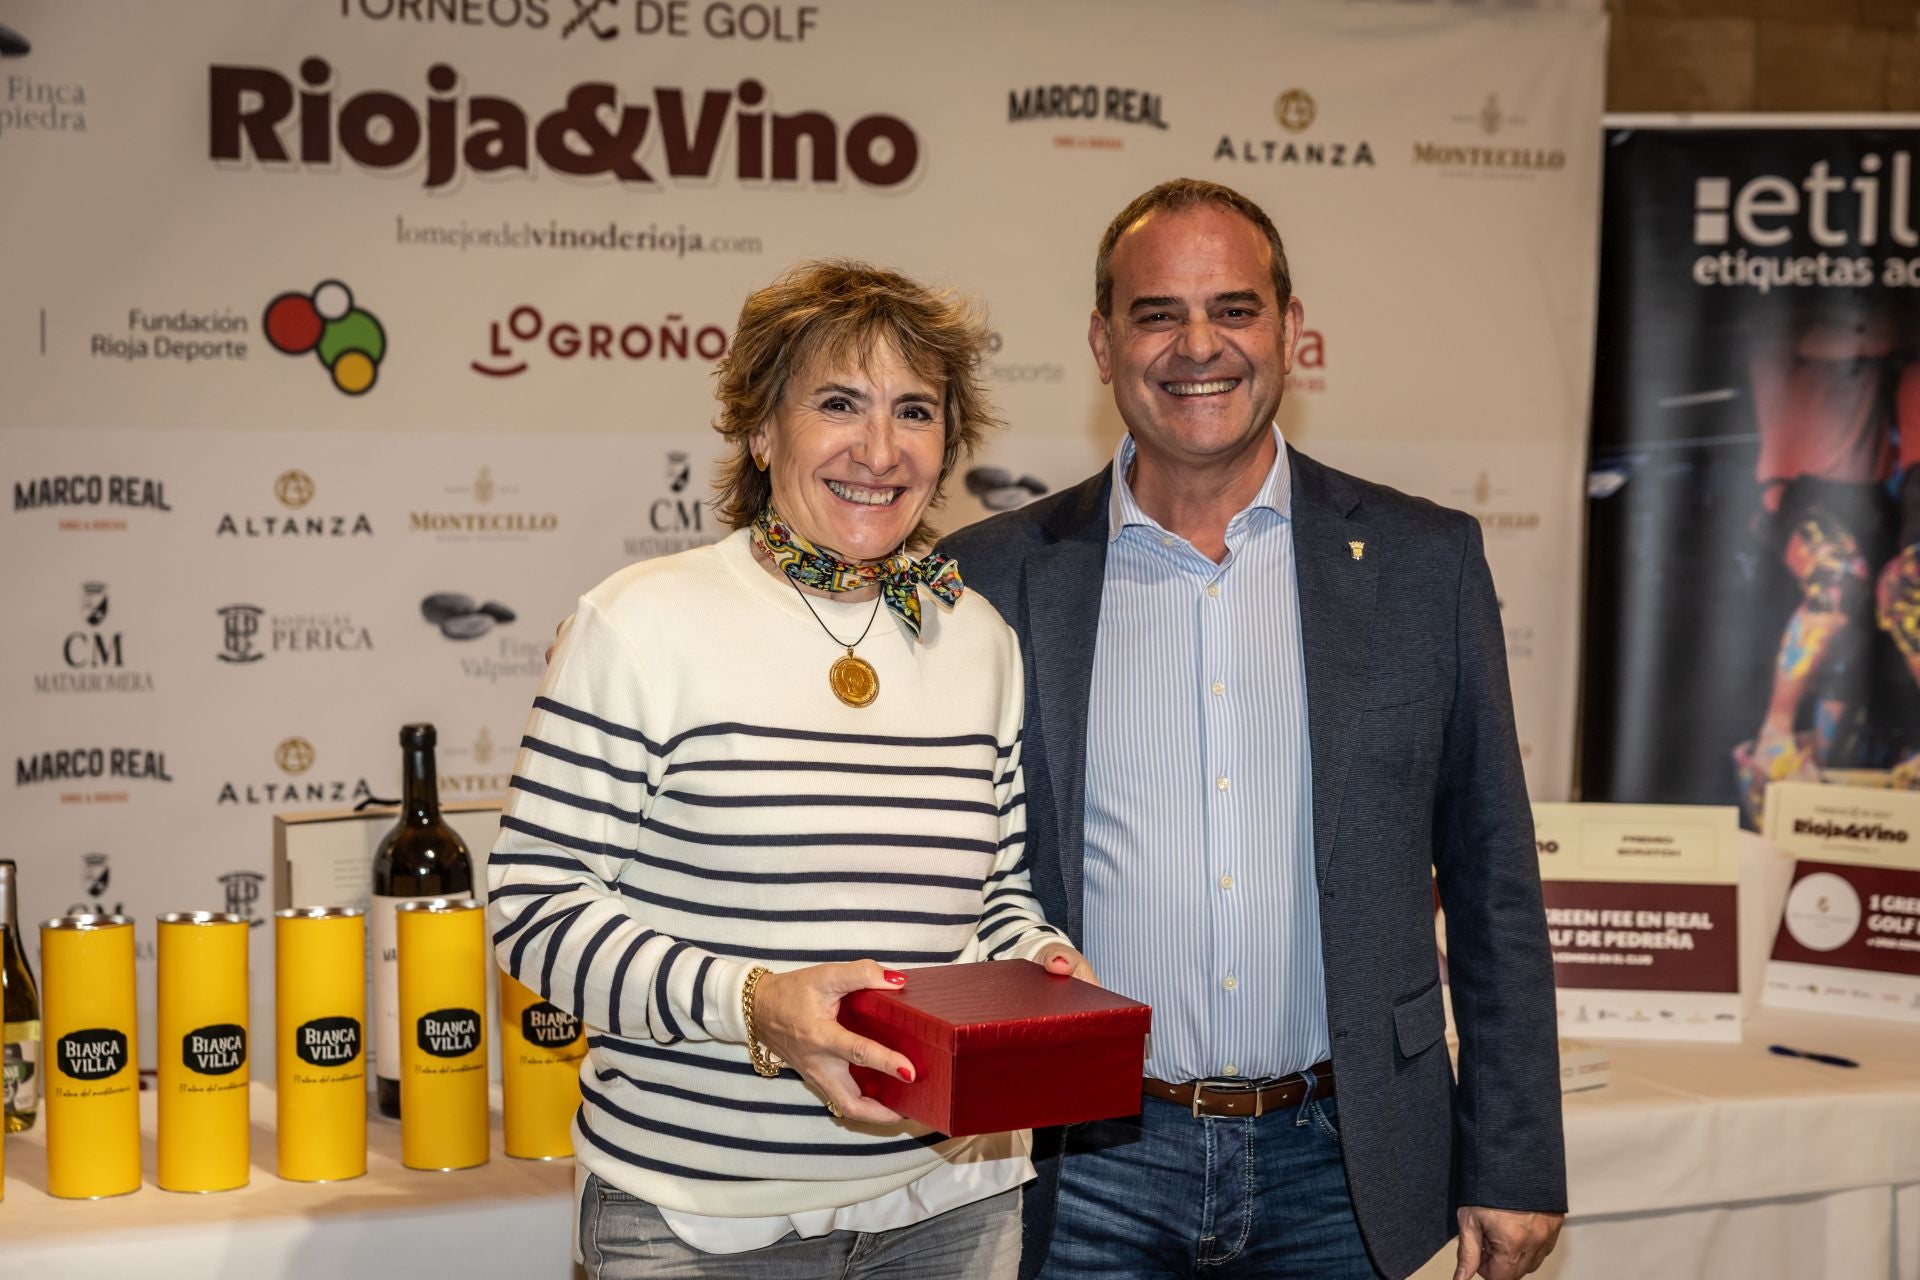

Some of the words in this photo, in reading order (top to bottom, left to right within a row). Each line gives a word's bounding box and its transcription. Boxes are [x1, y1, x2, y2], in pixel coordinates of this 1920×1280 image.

[635, 0, 690, 37] DE
[703, 2, 819, 43] GOLF
[8, 76, 87, 106] Finca
[1008, 83, 1099, 123] MARCO
[1104, 87, 1170, 131] REAL
[208, 56, 921, 190] Rioja&Vino
[1214, 135, 1376, 168] ALTANZA
[1411, 140, 1567, 173] MONTECILLO
[396, 215, 763, 259] lomejordelvinoderioja.com
[1692, 249, 1875, 294] etiquetas
[129, 307, 248, 334] Fundación
[490, 304, 727, 360] LOGROÑO
[91, 334, 149, 362] Rioja
[154, 335, 249, 363] Deporte
[14, 475, 103, 512] MARCO
[108, 475, 172, 512] REAL
[216, 514, 374, 537] ALTANZA
[409, 511, 558, 532] MONTECILLO
[649, 498, 703, 534] CM
[63, 631, 125, 669] CM
[271, 626, 374, 652] PERICA
[16, 745, 104, 787] MARCO
[109, 746, 173, 783] REAL
[217, 778, 373, 806] ALTANZA
[1794, 817, 1909, 844] Rioja&Vino
[1545, 908, 1600, 927] REEN
[1601, 910, 1635, 928] FEE
[1635, 911, 1663, 928] EN
[1664, 912, 1714, 931] REAL
[1575, 930, 1603, 948] DE
[305, 1027, 356, 1047] BIANCA
[424, 1019, 476, 1038] BIANCA
[536, 1024, 577, 1042] VILLA
[64, 1039, 120, 1060] BIANCA
[192, 1035, 242, 1055] BIANCA
[310, 1043, 353, 1060] VILLA
[430, 1034, 472, 1052] VILLA
[70, 1056, 117, 1074] VILLA
[197, 1051, 239, 1069] VILLA
